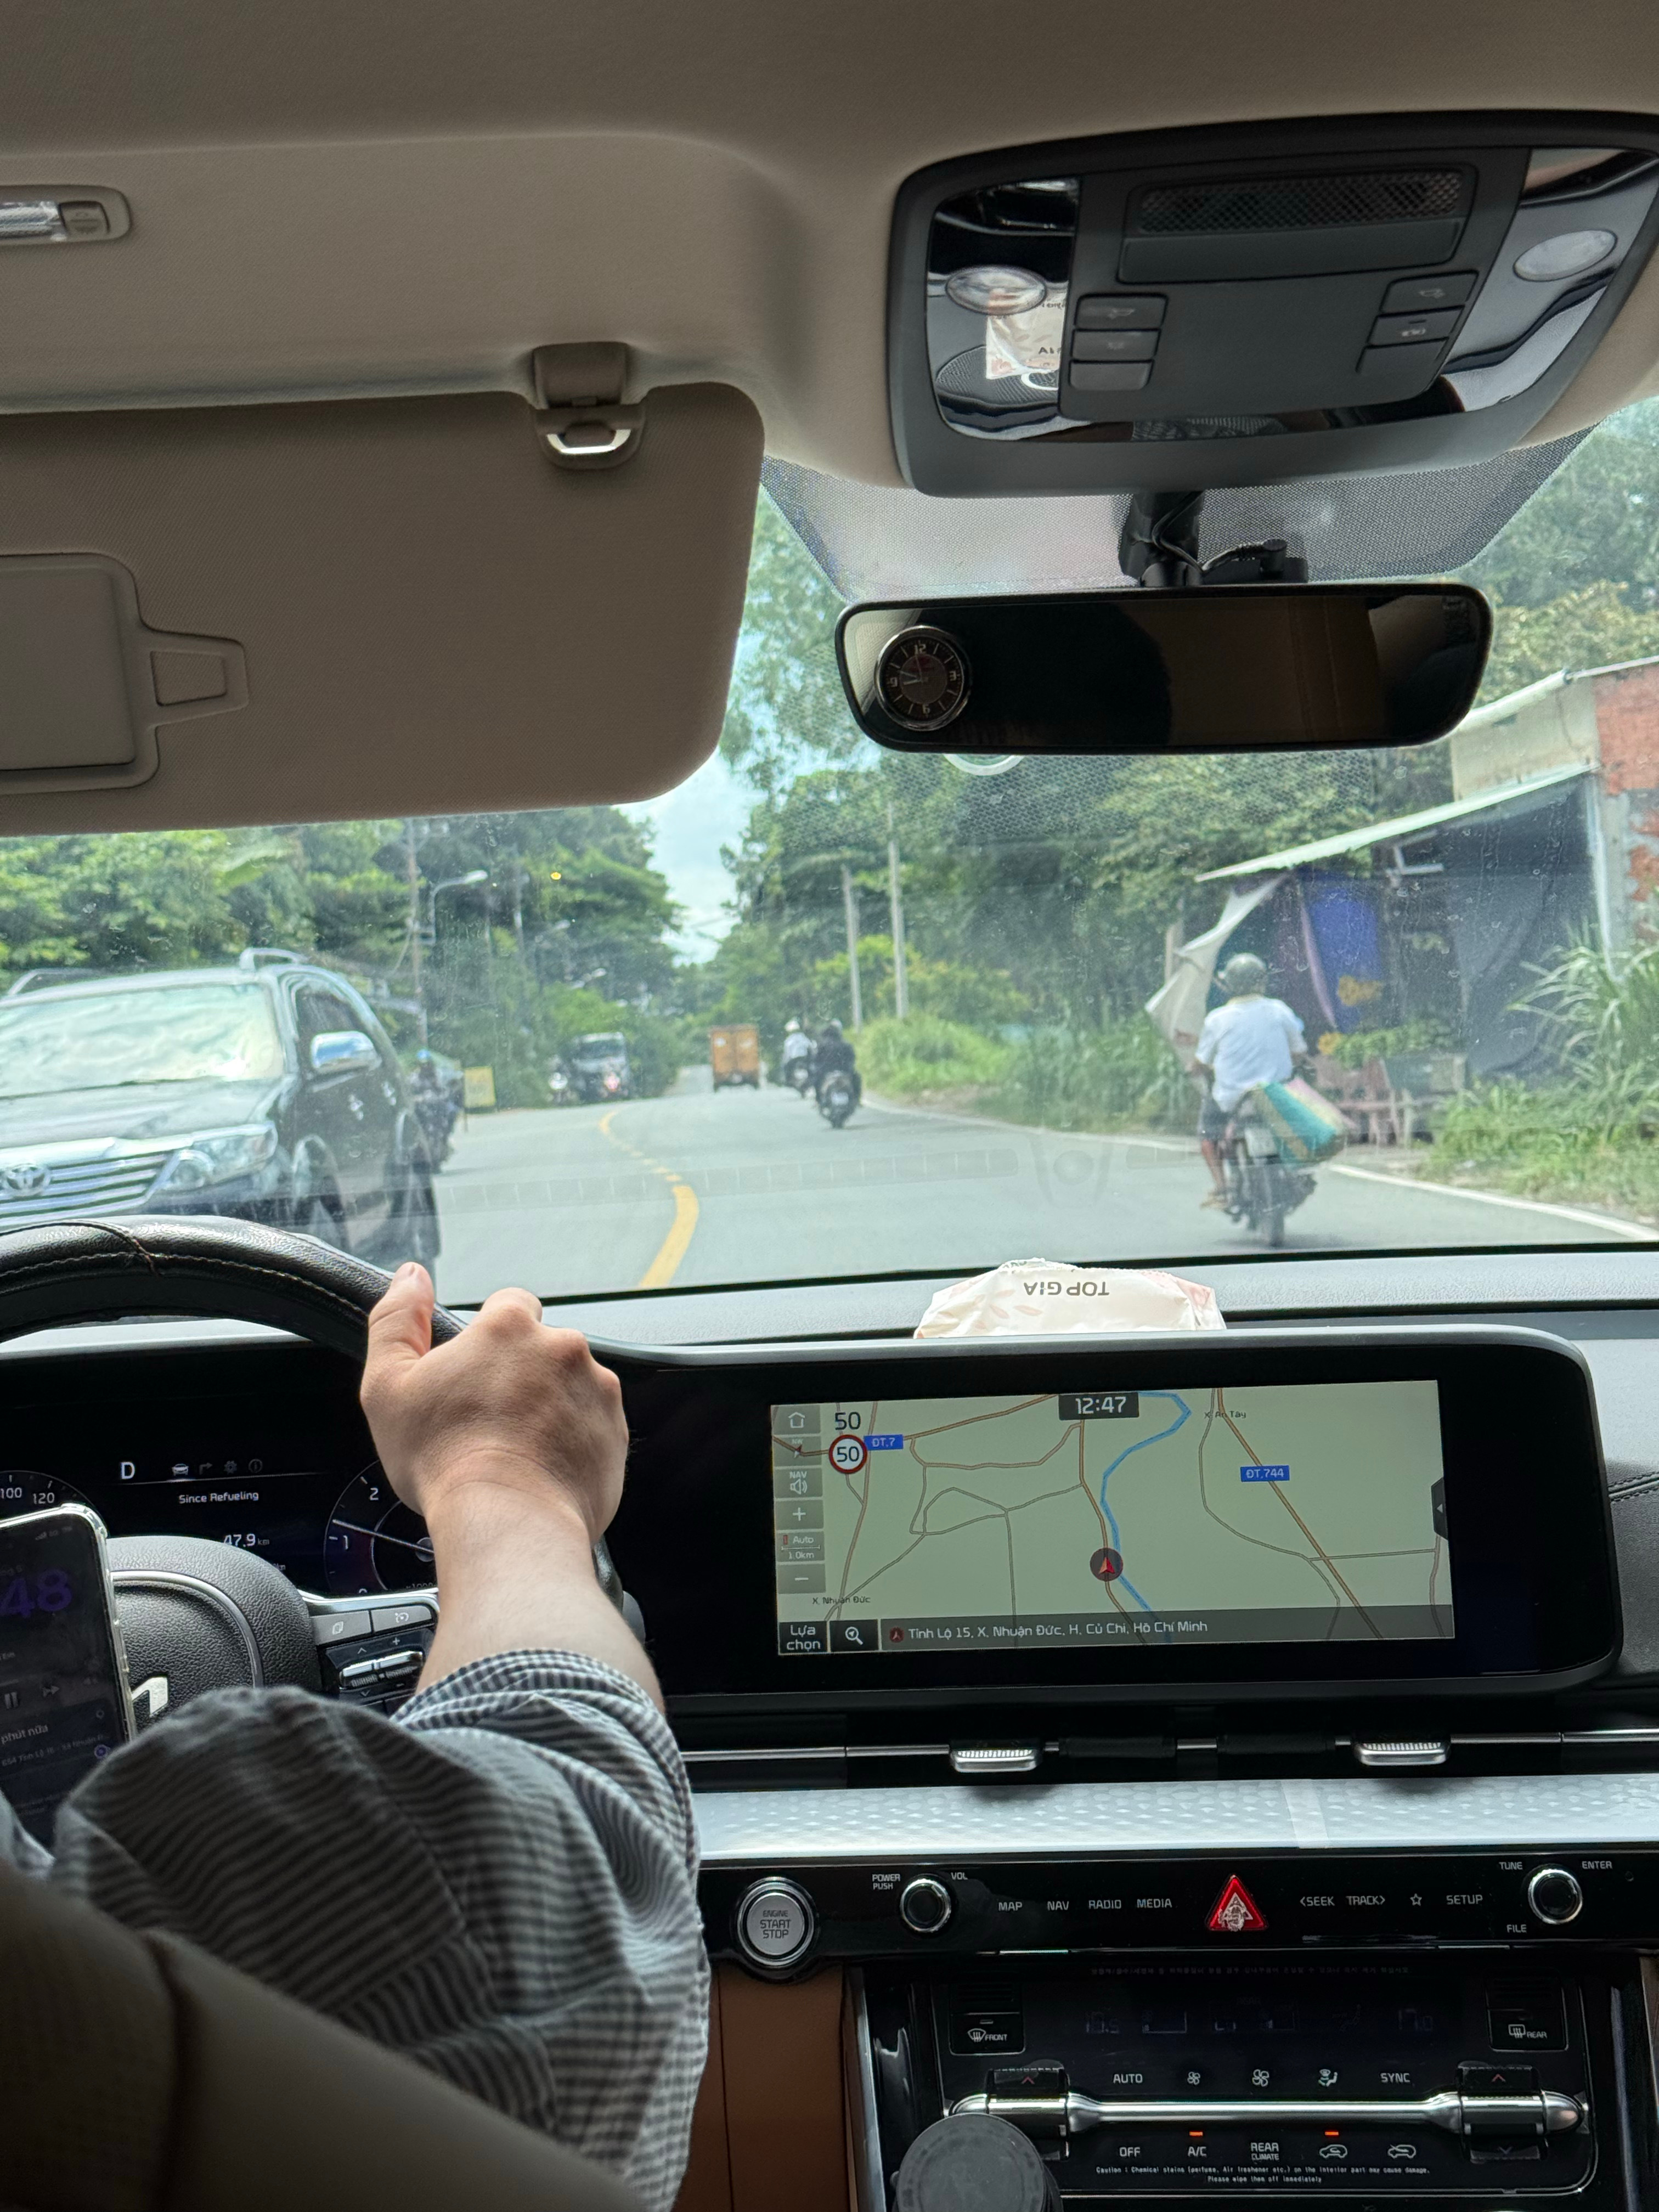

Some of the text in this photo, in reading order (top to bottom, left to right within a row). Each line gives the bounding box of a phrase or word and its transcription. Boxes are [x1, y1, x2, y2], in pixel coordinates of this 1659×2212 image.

[914, 644, 927, 653] 12
[949, 671, 957, 681] 3
[890, 676, 898, 687] 9
[922, 704, 930, 714] 6
[1024, 1282, 1110, 1296] TOP GIA
[1075, 1396, 1127, 1415] 12:47
[834, 1412, 861, 1430] 50
[837, 1446, 860, 1462] 50
[120, 1462, 135, 1480] D
[789, 1471, 807, 1479] NAV
[0, 1487, 22, 1499] 100
[32, 1492, 55, 1504] 120
[179, 1491, 259, 1504] Since Refueling
[369, 1487, 379, 1501] 2
[223, 1533, 256, 1548] 47.9
[343, 1535, 349, 1550] 1
[790, 1624, 817, 1638] Lựa
[993, 1625, 1032, 1639] Nhuận
[1178, 1620, 1209, 1632] Minh
[787, 1639, 821, 1652] chọn
[1499, 1861, 1523, 1870] TUNE
[1582, 1860, 1612, 1870] ENTER
[872, 1874, 901, 1882] POWER
[951, 1872, 968, 1880] VOL
[1088, 1899, 1122, 1909] RADIO
[1136, 1898, 1172, 1908] MEDIA
[1446, 1895, 1483, 1905] SETUP
[998, 1901, 1023, 1911] MAP
[1047, 1901, 1069, 1911] NAV
[759, 1919, 791, 1929] START
[1506, 1924, 1527, 1933] FILE
[763, 1929, 789, 1939] STOP
[1526, 2031, 1548, 2039] REAR
[1113, 2073, 1143, 2083] AUTO
[1380, 2073, 1410, 2083] SYNC
[1119, 2147, 1141, 2157] OFF
[1188, 2146, 1207, 2157] A/C
[1250, 2142, 1279, 2152] REAR
